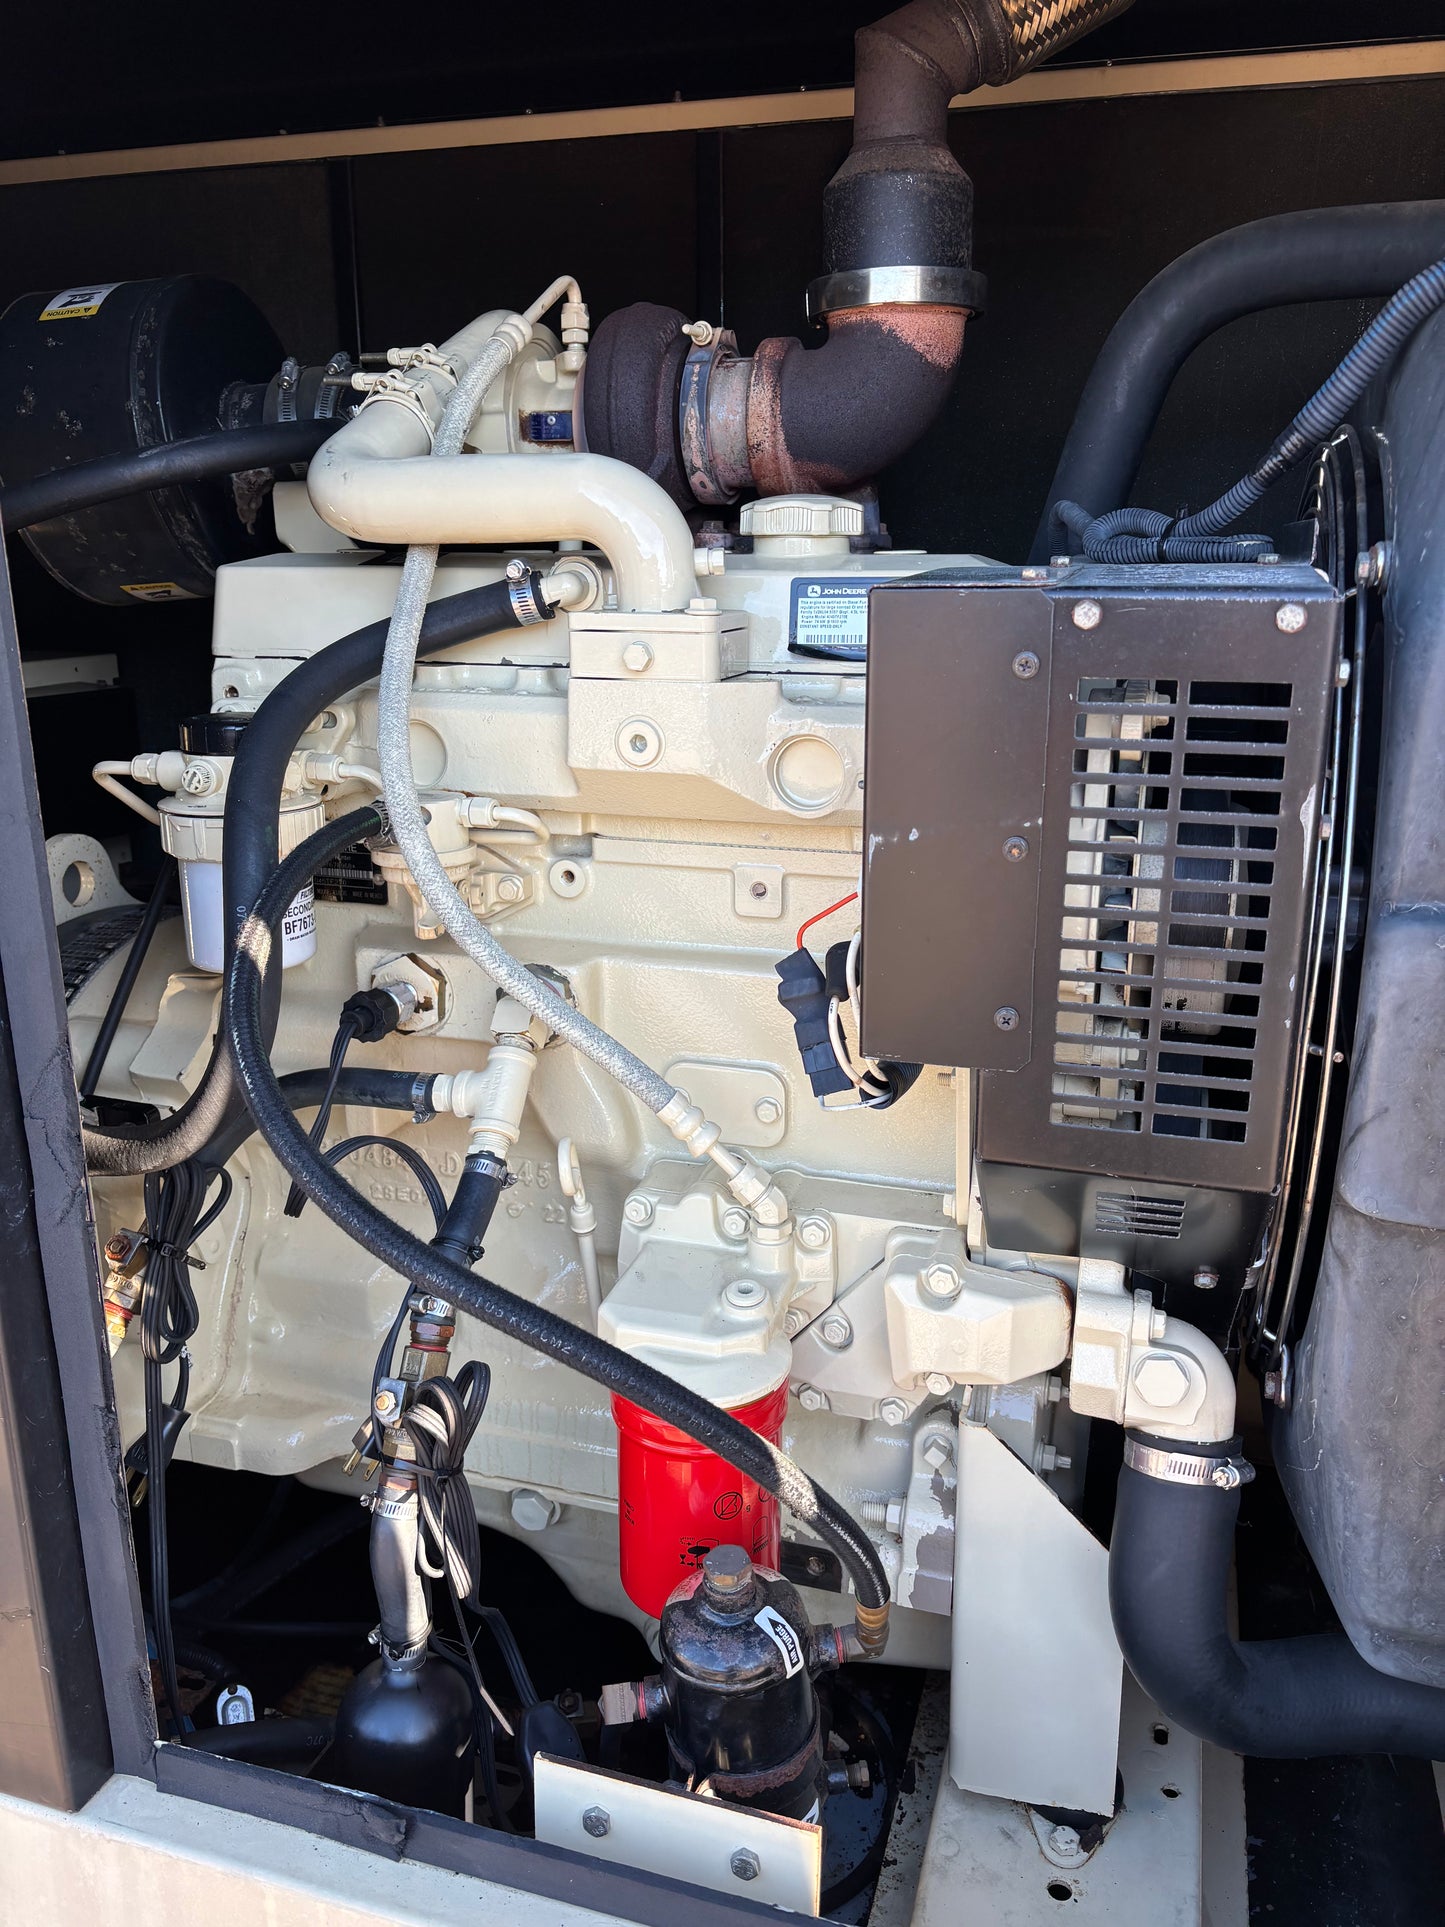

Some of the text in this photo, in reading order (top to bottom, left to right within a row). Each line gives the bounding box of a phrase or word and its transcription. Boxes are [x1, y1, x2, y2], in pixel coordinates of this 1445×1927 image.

[46, 308, 80, 317] CAUTION
[842, 587, 867, 595] DEERE
[775, 1624, 798, 1664] AIR PURGE
